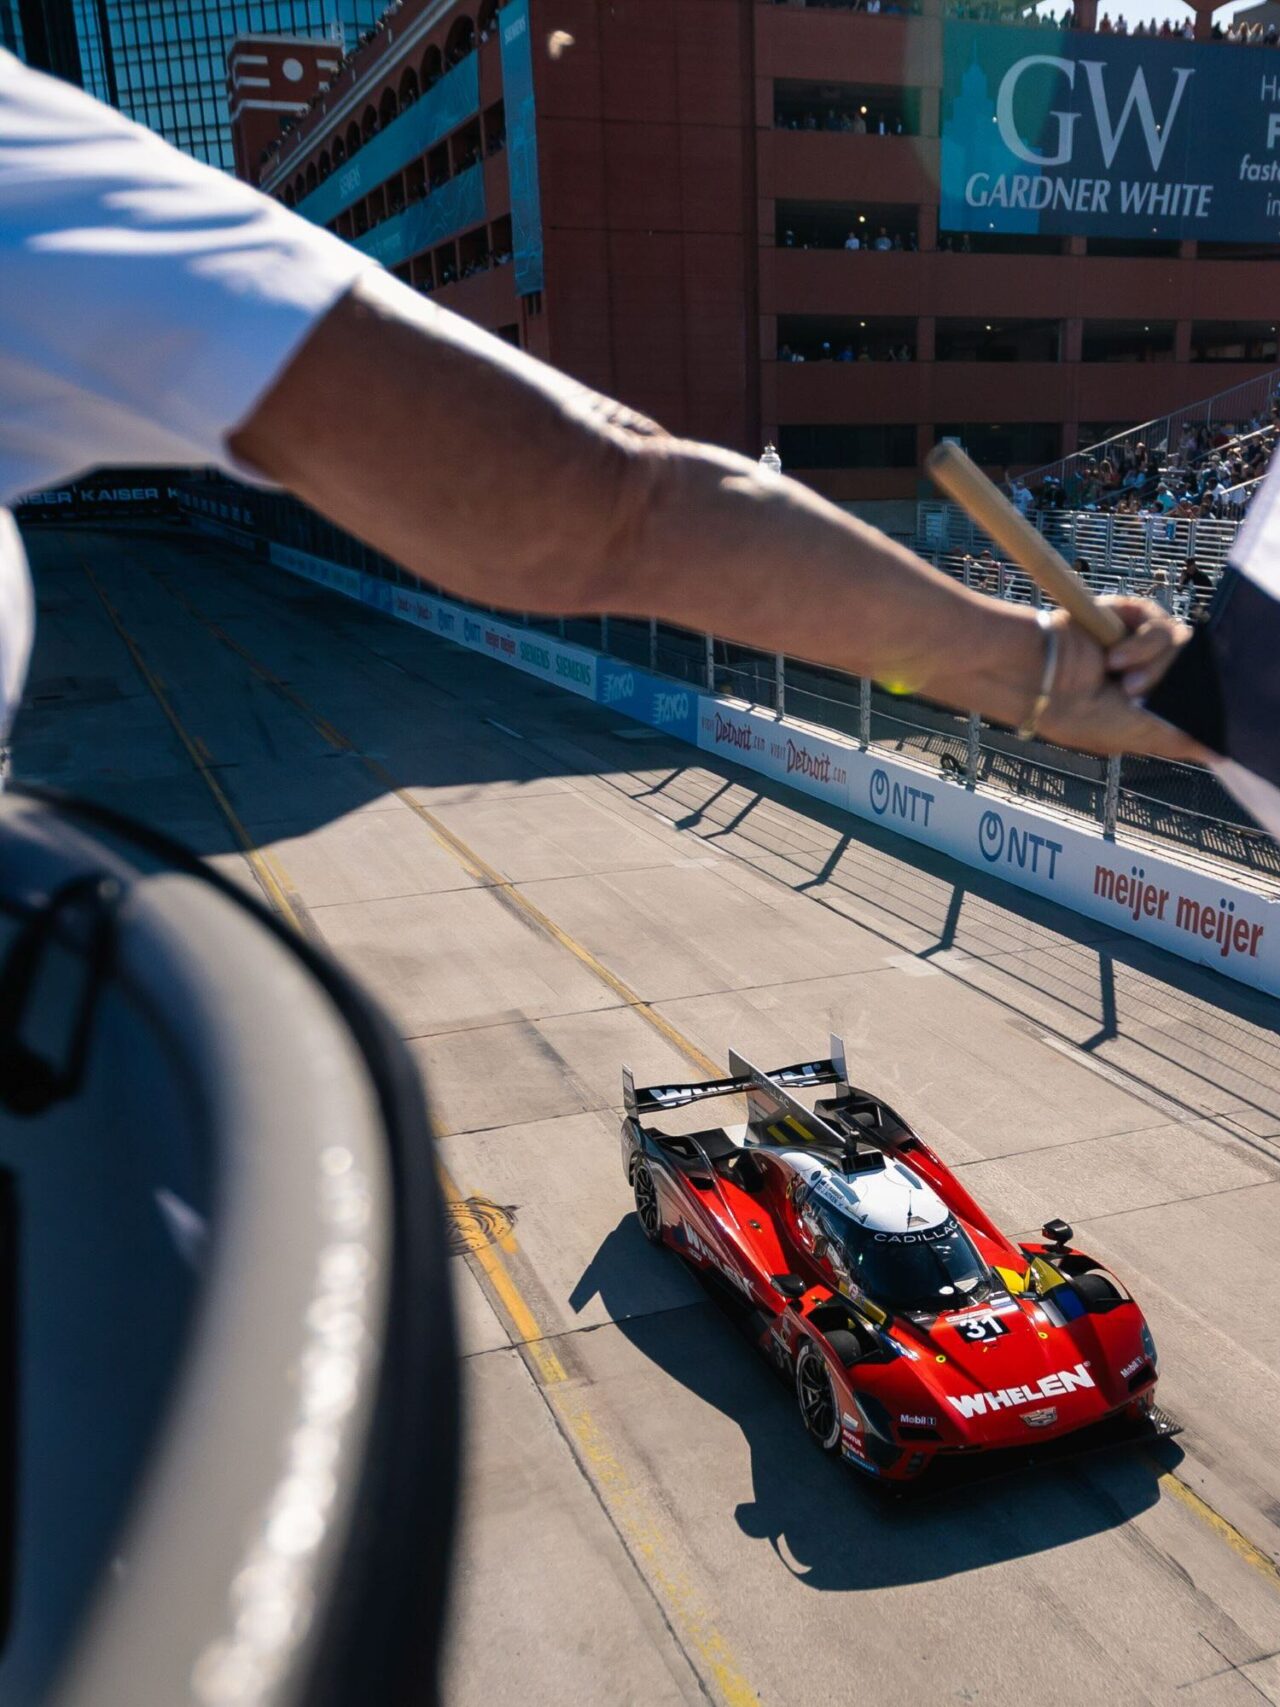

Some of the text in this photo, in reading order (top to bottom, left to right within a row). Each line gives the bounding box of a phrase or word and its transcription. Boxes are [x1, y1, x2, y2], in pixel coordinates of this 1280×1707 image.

[996, 54, 1195, 172] GW
[964, 172, 1214, 217] GARDNER WHITE
[19, 490, 73, 504] ISER
[81, 486, 159, 502] KAISER
[555, 653, 591, 687] SIEMENS
[715, 711, 752, 751] Detroit
[786, 738, 831, 784] Detroit
[892, 784, 935, 827] NTT
[1007, 825, 1064, 880] NTT
[1094, 865, 1265, 958] meijer meijer
[874, 1220, 959, 1244] CADILLAC
[959, 1314, 1003, 1339] 31
[946, 1363, 1096, 1419] WHELEN
[900, 1414, 926, 1425] Mobil
